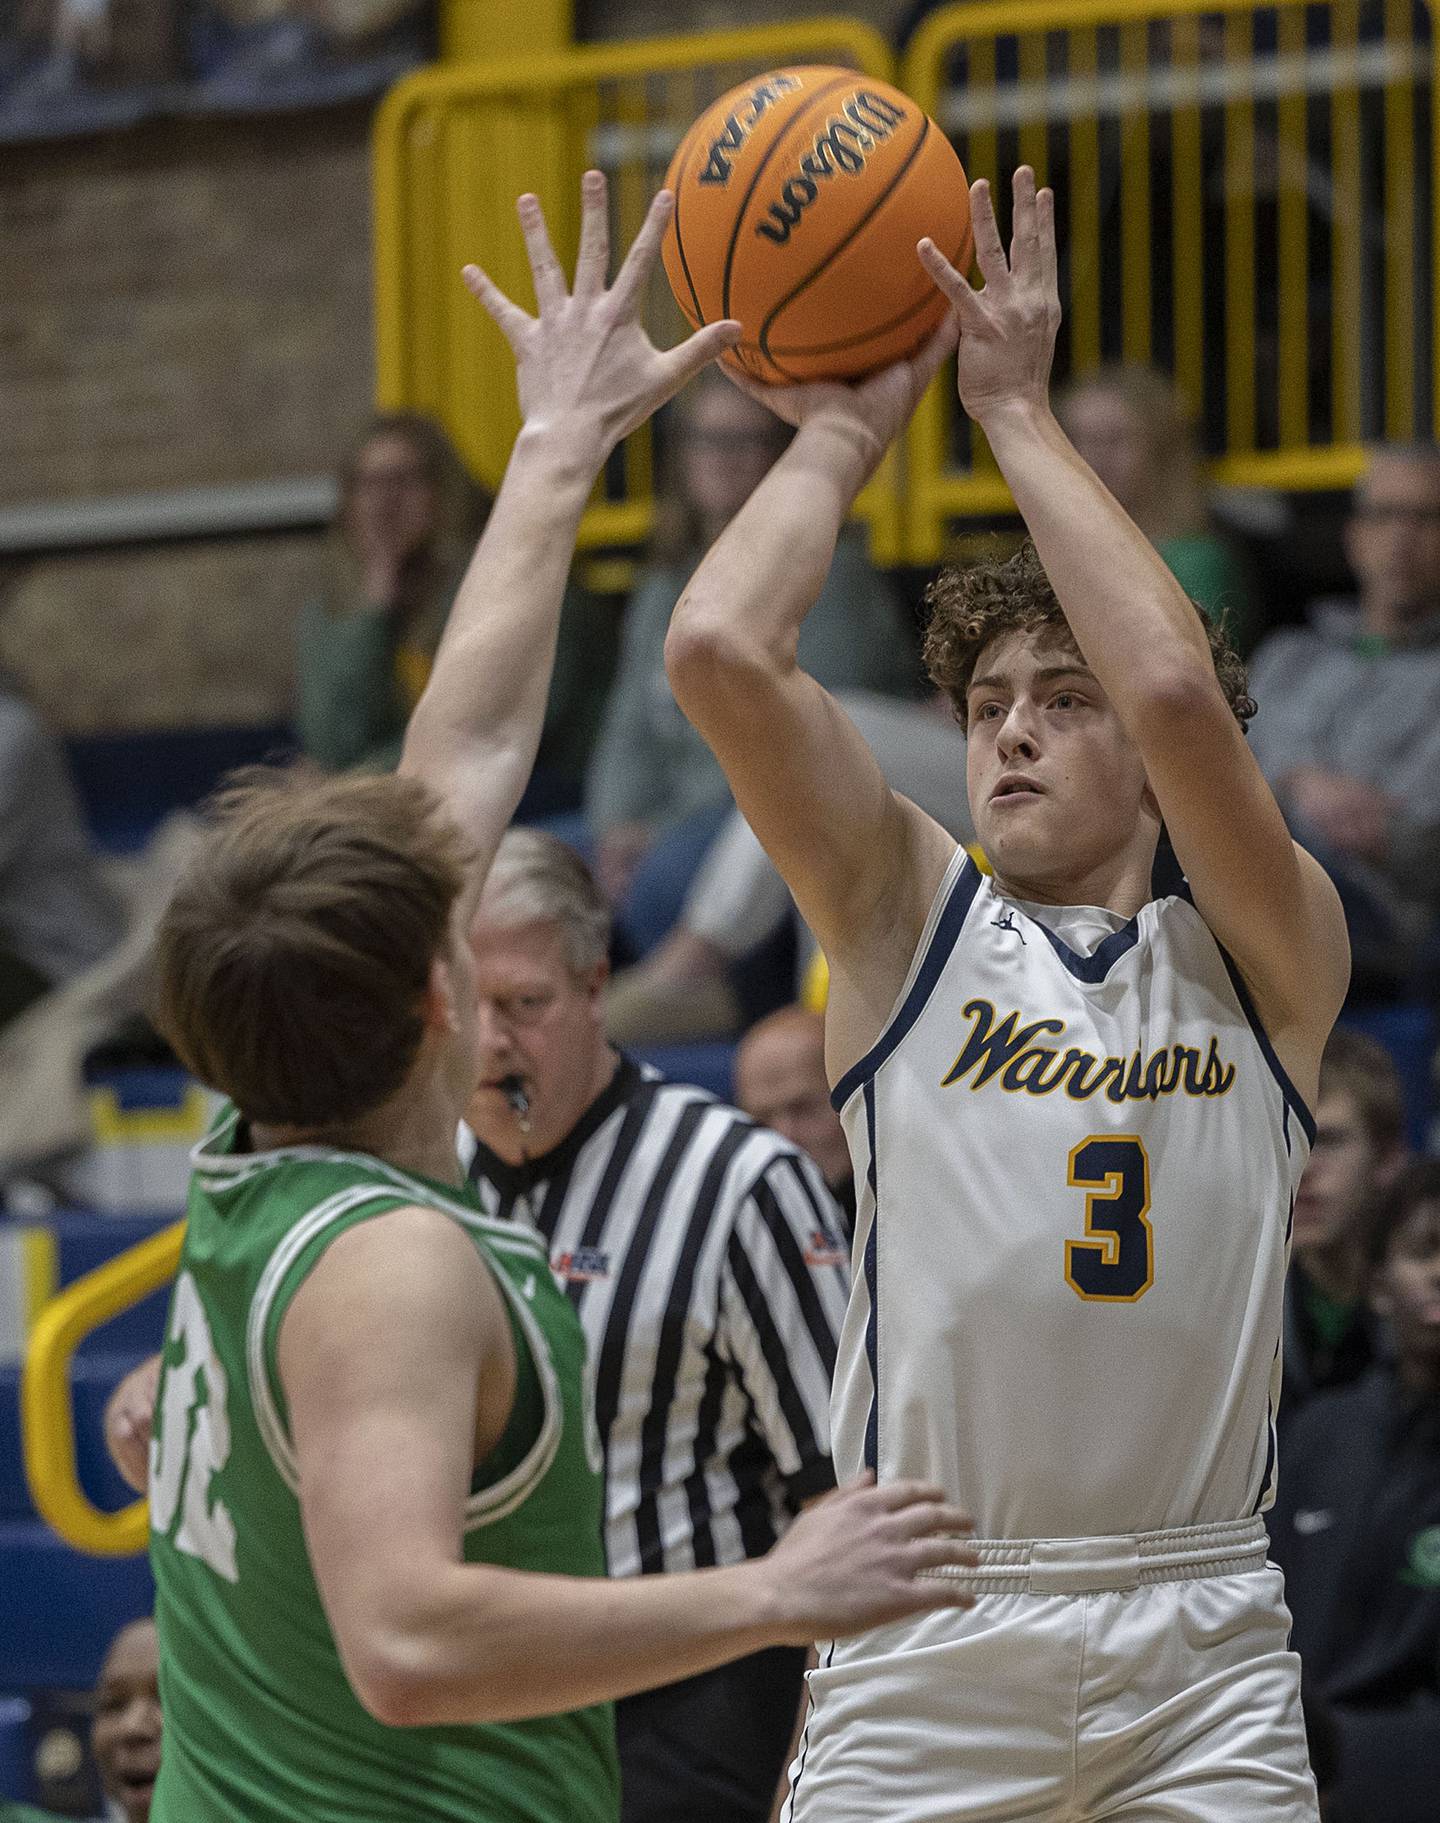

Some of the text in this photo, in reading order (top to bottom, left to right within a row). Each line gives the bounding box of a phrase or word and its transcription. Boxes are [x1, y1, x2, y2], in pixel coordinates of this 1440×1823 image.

[757, 91, 905, 244] Wilson
[940, 999, 1236, 1104] Warriors
[1064, 1134, 1154, 1303] 3
